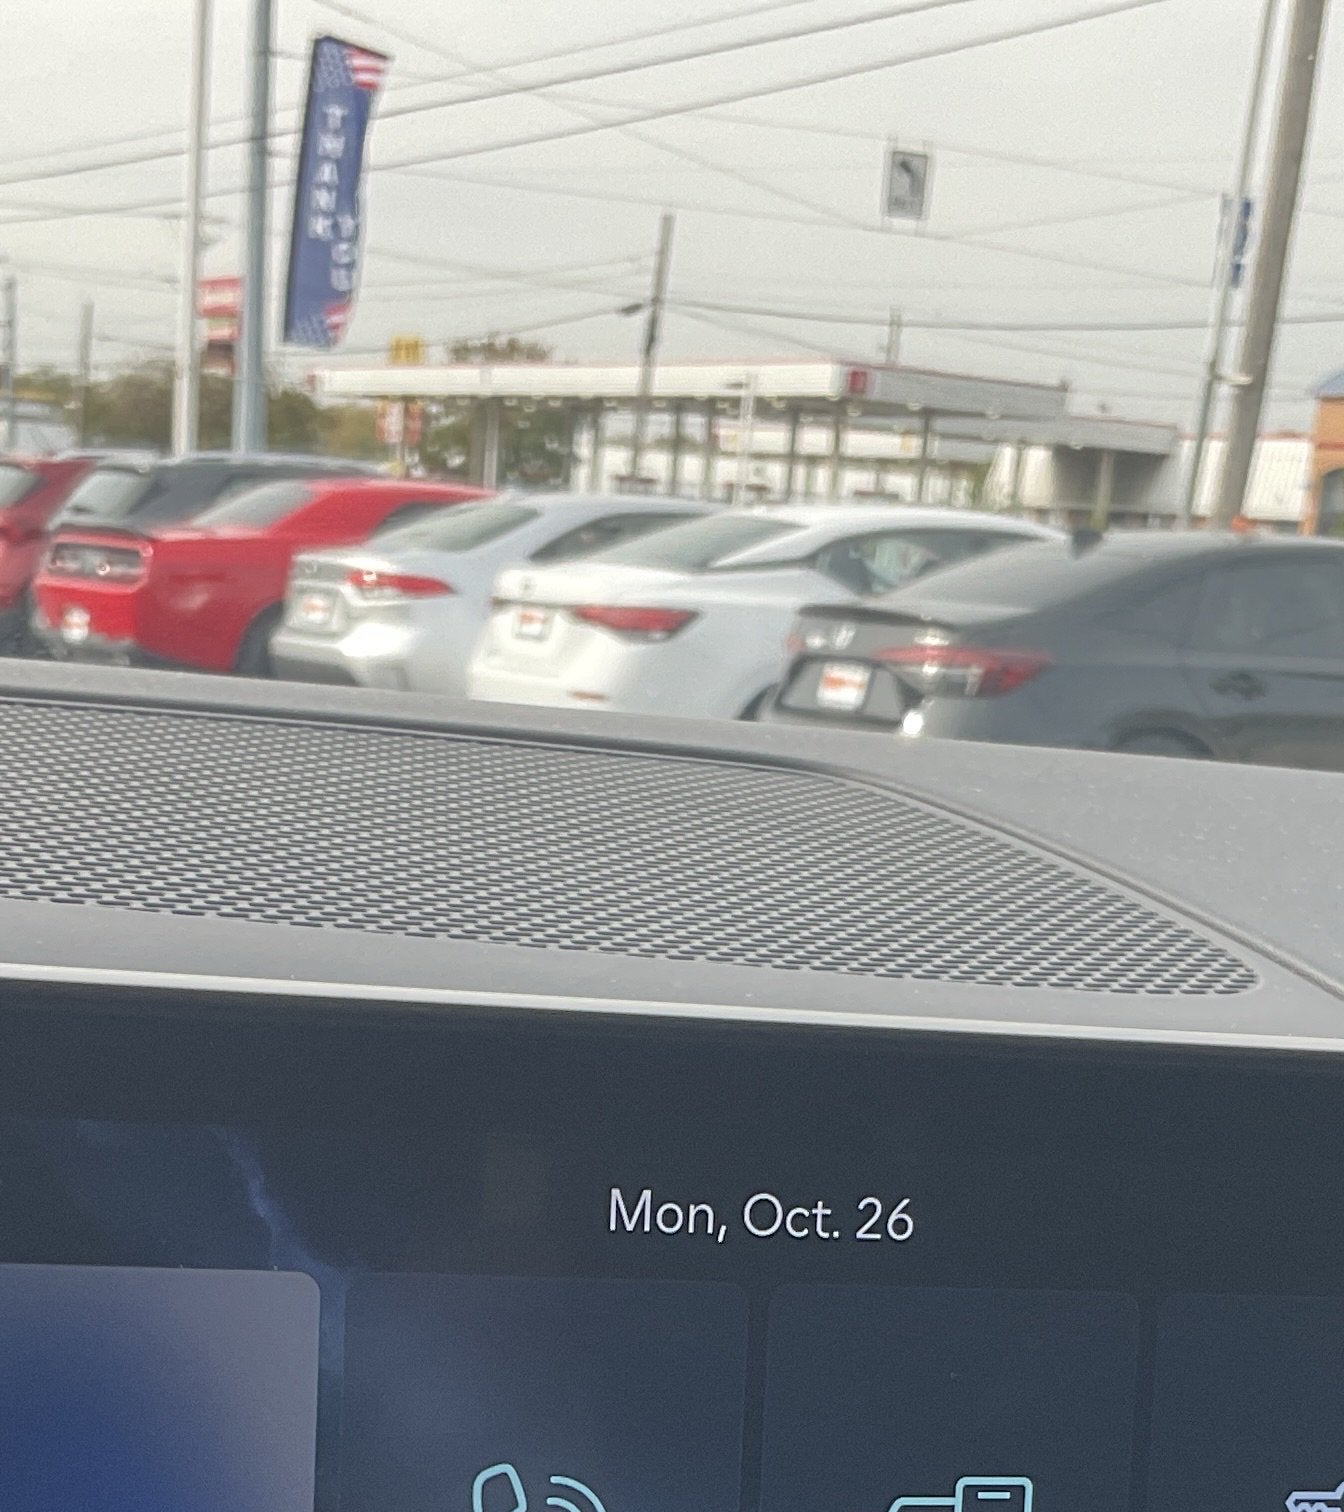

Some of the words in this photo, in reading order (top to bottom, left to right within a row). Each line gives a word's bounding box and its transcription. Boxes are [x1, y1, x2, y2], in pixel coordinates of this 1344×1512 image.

[608, 1187, 728, 1244] Mon,
[742, 1191, 841, 1240] Oct.
[854, 1195, 915, 1242] 26
